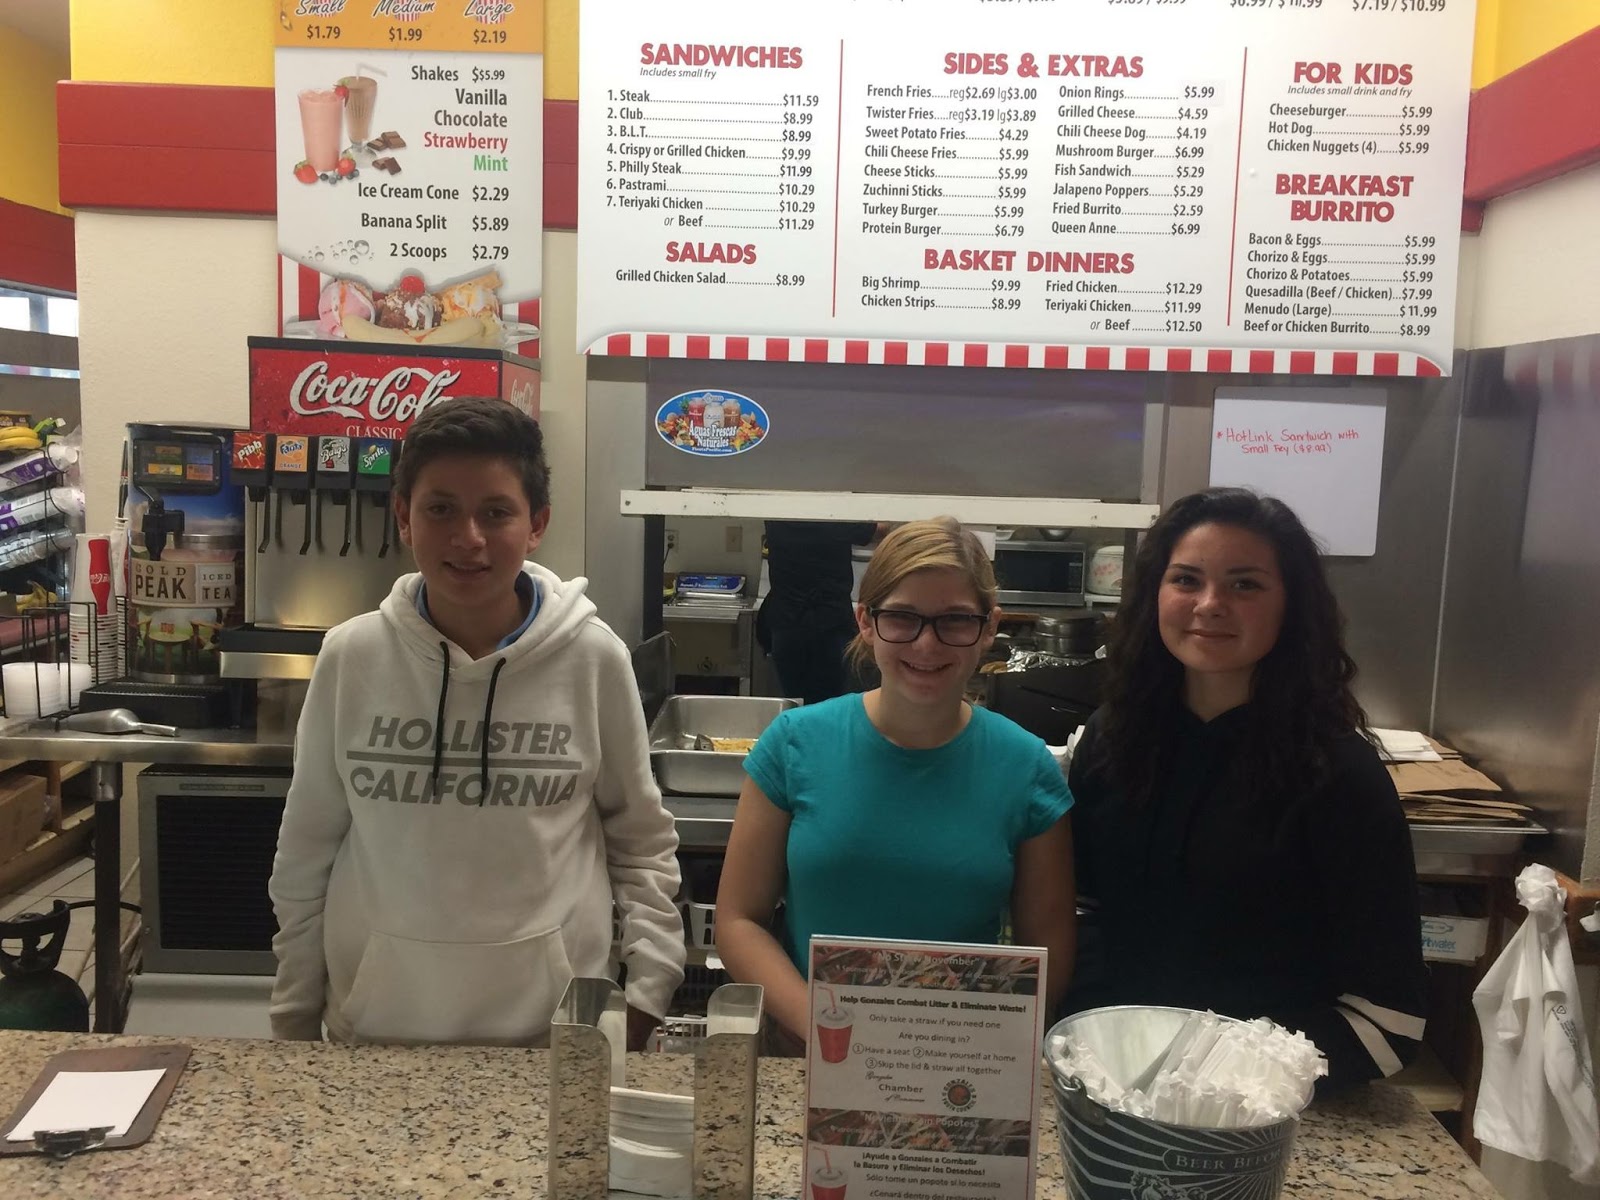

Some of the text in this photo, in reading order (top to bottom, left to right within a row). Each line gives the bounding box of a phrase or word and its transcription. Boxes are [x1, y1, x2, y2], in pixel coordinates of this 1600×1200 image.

[464, 0, 513, 21] Large
[307, 25, 341, 40] $1.79
[389, 27, 422, 42] $1.99
[473, 29, 506, 44] $2.19
[640, 43, 803, 69] SANDWICHES
[944, 52, 1144, 78] SIDES & EXTRAS
[411, 66, 459, 81] Shakes
[640, 67, 717, 80] Includes small fry
[1294, 62, 1413, 85] FOR KIDS
[455, 89, 507, 106] Vanilla
[608, 90, 819, 107] 1. Steak $11.59
[867, 85, 903, 98] French
[906, 86, 931, 98] Fries
[1059, 85, 1214, 101] Onion Rings $5.99
[1287, 85, 1413, 98] Includes small drink and fry
[434, 110, 507, 127] Chocolate
[607, 108, 813, 125] 2. Club $8.99
[1269, 103, 1432, 119] Cheeseburger $5.99
[865, 126, 1028, 141] Sweet Potato Fries $4.29
[424, 132, 508, 153] Strawberry
[1267, 139, 1429, 155] Chicken Nuggets (4) $5.99
[607, 143, 811, 160] 4. Crispy or Grilled Chicken $9.99
[1056, 145, 1204, 161] Mushroom Burger $6.99
[473, 154, 508, 172] Mint
[607, 161, 812, 177] 5. Philly Steak $11.99
[358, 183, 509, 202] Ice Cream Cone $2.29
[863, 184, 1026, 199] Zuchinni Sticks $5.99
[1053, 184, 1203, 199] Jalapeno Poppers $5.29
[1275, 174, 1414, 197] BREAKFAST
[1291, 200, 1394, 223] BURRITO
[361, 213, 509, 232] Banana Split $5.89
[1051, 221, 1201, 236] Queen Anne $6.99
[1249, 233, 1435, 249] Bacon & Eggs $5.99
[390, 243, 509, 261] 2 Scoops $2.79
[666, 241, 757, 265] SALADS
[924, 249, 1135, 274] BASKET DINNERS
[616, 270, 805, 286] Grilled Chicken Salad $8.99
[862, 276, 1021, 292] Big Shrimp $9.99
[1045, 299, 1201, 314] Teriyaki Chicken $11.99
[290, 360, 461, 422] Coca-Col
[346, 424, 402, 440] CLASSIC
[1338, 430, 1359, 439] with
[238, 441, 262, 460] Pibb
[364, 446, 385, 467] Sprite
[1241, 444, 1268, 454] Small
[135, 574, 187, 599] PEAK
[202, 587, 232, 600] TEA
[367, 716, 572, 755] HOLLISTER
[350, 767, 578, 807] CALIFORNIA
[840, 996, 858, 1004] Help
[897, 998, 927, 1007] Combat
[931, 1034, 956, 1043] dining
[932, 1064, 953, 1072] straw
[967, 1066, 1001, 1075] together
[879, 1083, 923, 1093] Chamber
[1176, 1155, 1225, 1169] BEER
